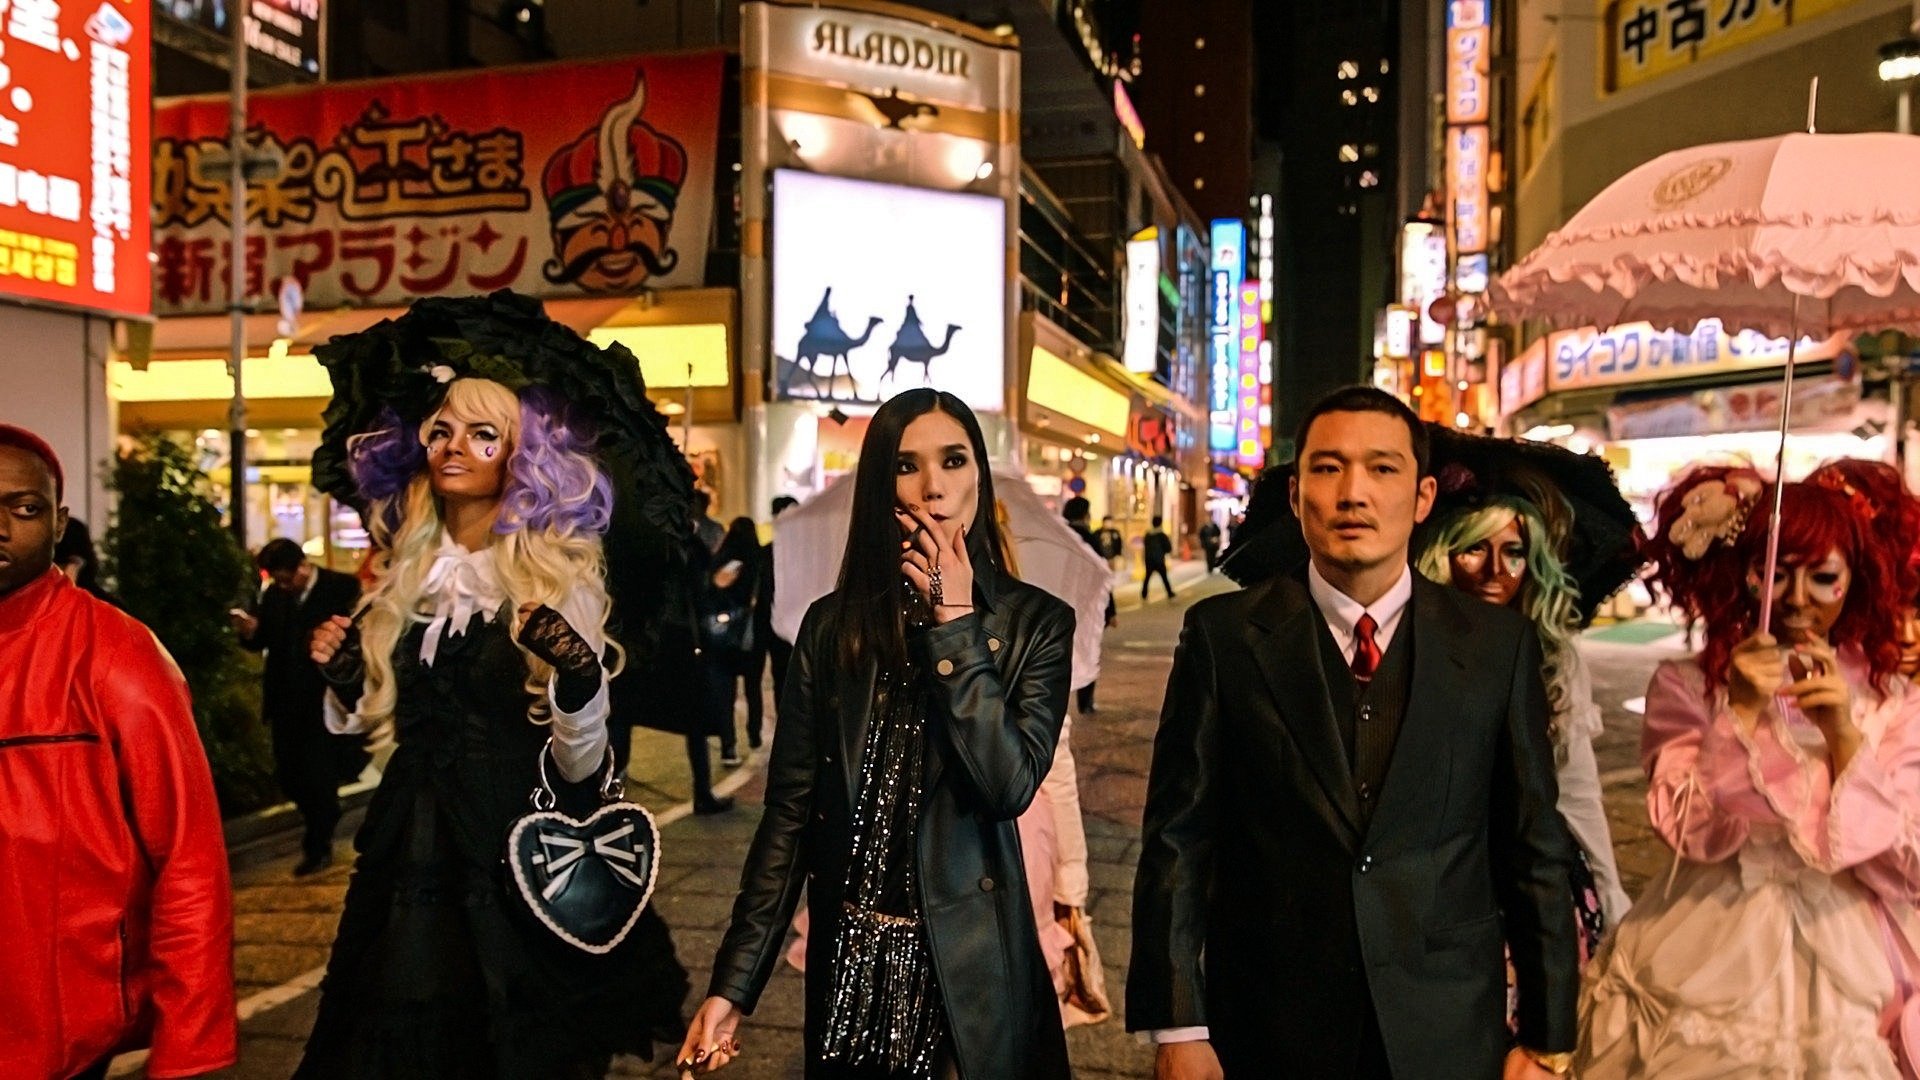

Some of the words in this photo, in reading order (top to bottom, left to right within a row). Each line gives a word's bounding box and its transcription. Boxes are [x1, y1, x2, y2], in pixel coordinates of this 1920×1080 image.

[814, 20, 970, 79] ALADDIN
[157, 220, 529, 305] 新宿アラジン
